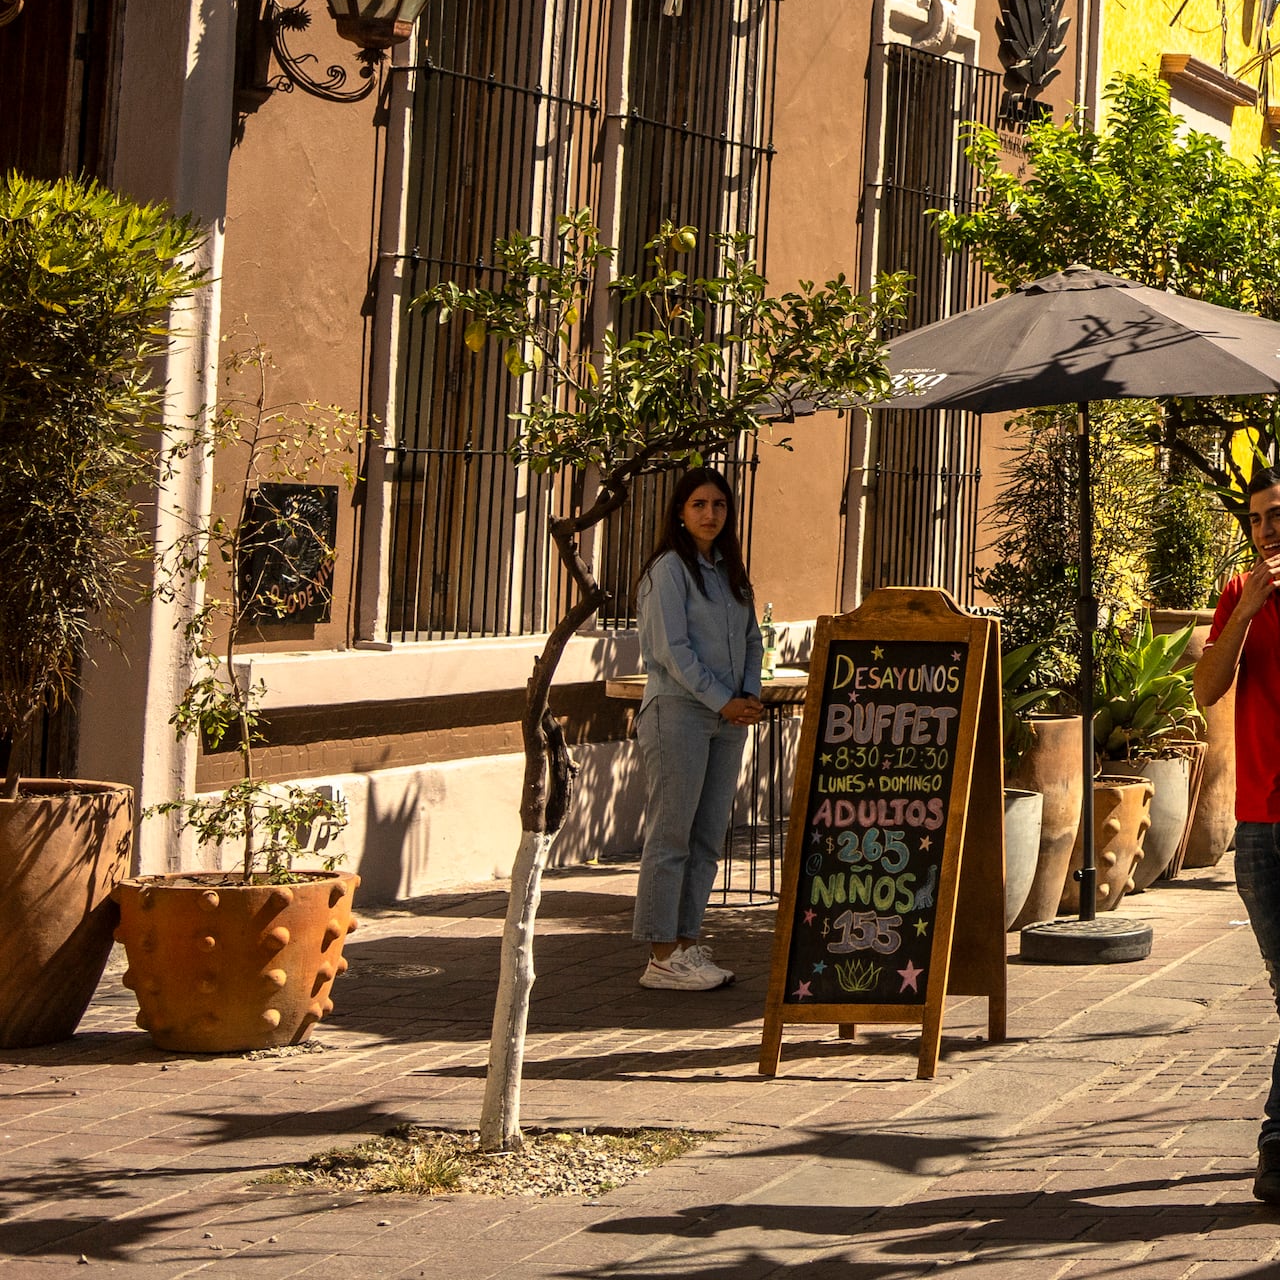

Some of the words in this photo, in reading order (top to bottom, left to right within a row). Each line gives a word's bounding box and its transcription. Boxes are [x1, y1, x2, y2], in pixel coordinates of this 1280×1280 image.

[833, 654, 959, 693] DESAYUNOS
[824, 702, 959, 745] BUFFET
[818, 774, 866, 793] LUNES
[879, 774, 943, 794] DOMINGO
[812, 797, 944, 830] ADULTOS
[825, 827, 910, 874] $265
[810, 864, 916, 914] NIÑOS
[820, 909, 903, 954] $155
